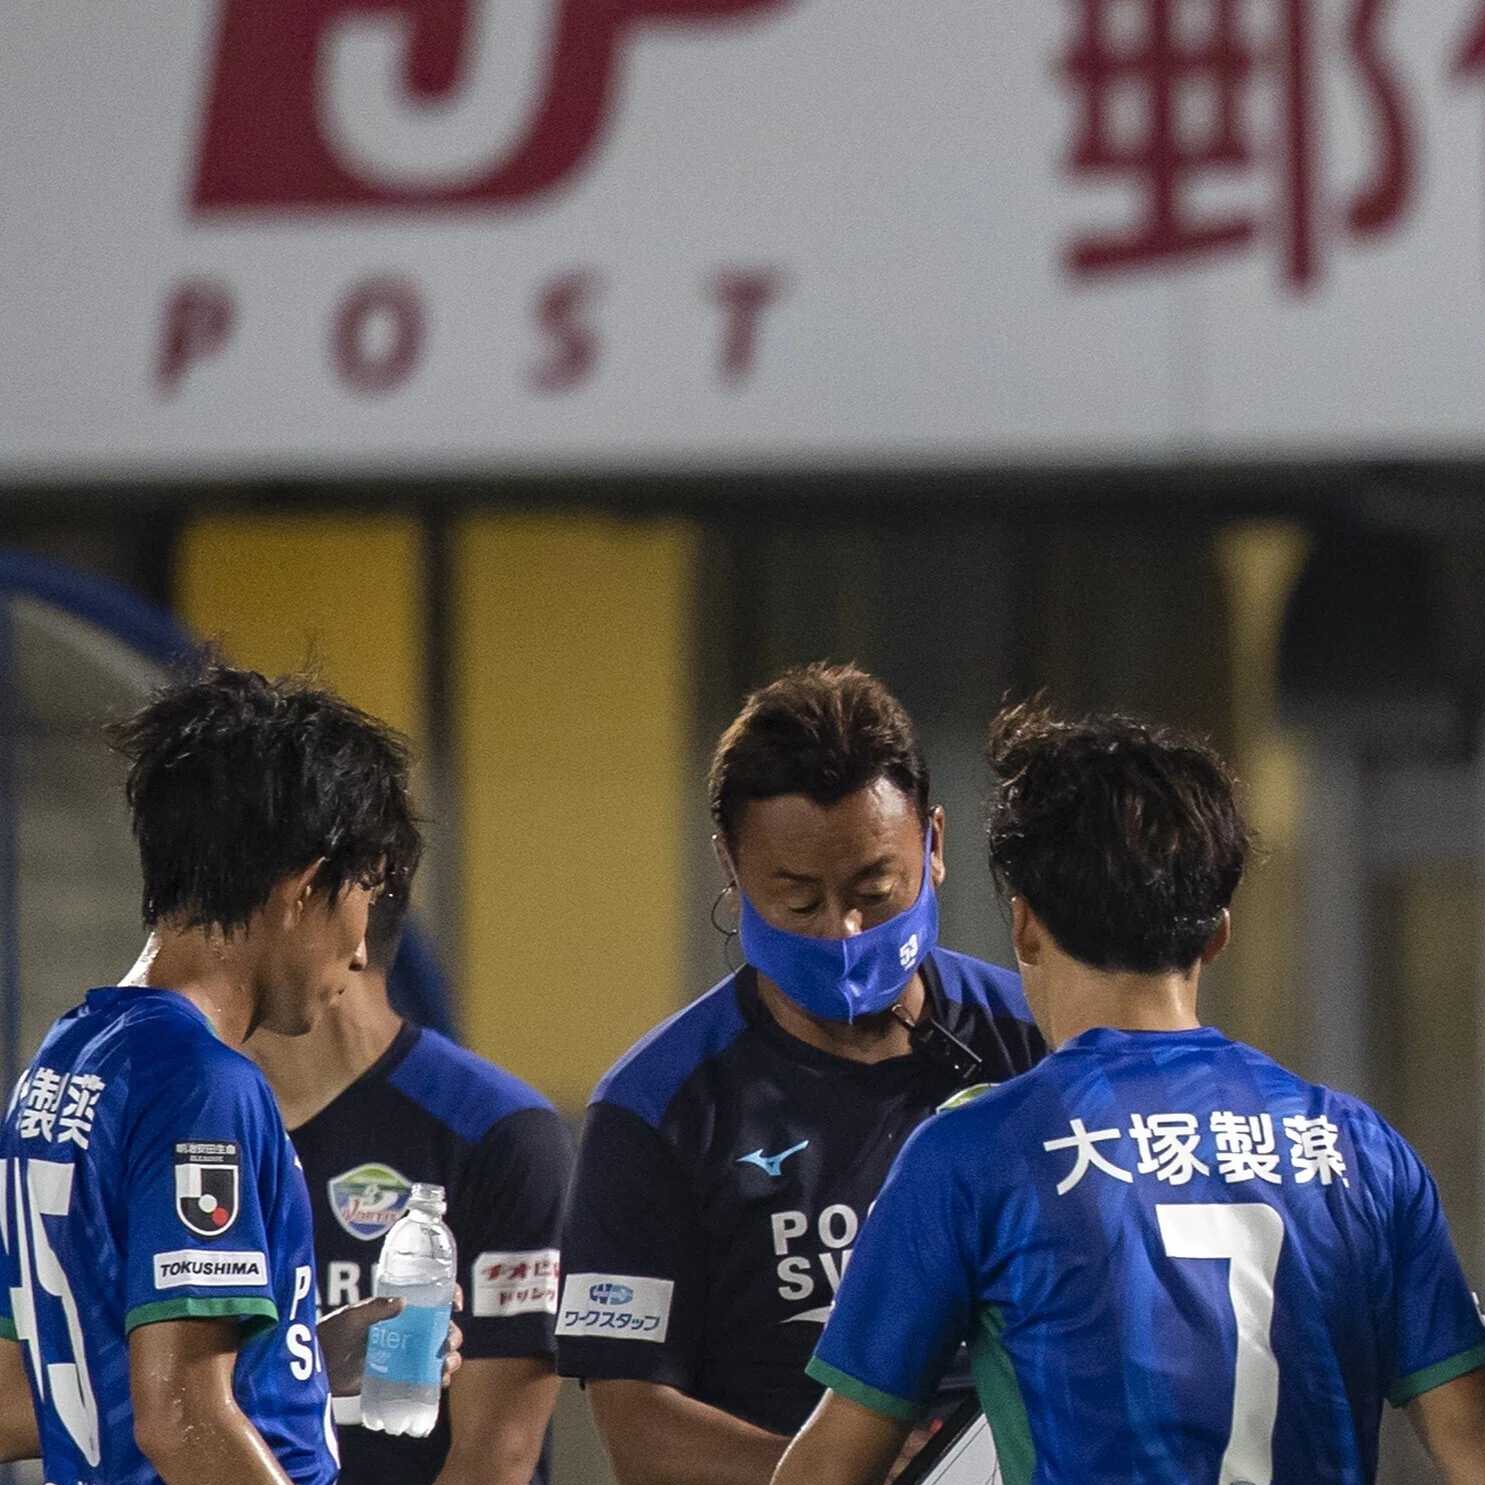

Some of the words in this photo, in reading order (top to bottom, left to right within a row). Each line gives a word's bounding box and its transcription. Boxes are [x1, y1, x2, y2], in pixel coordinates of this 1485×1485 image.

[151, 269, 784, 400] POST
[5, 1067, 106, 1150] 製薬
[1044, 1111, 1348, 1195] 大塚製薬
[160, 1260, 260, 1278] TOKUSHIMA
[565, 1310, 661, 1331] ワークスタッフ
